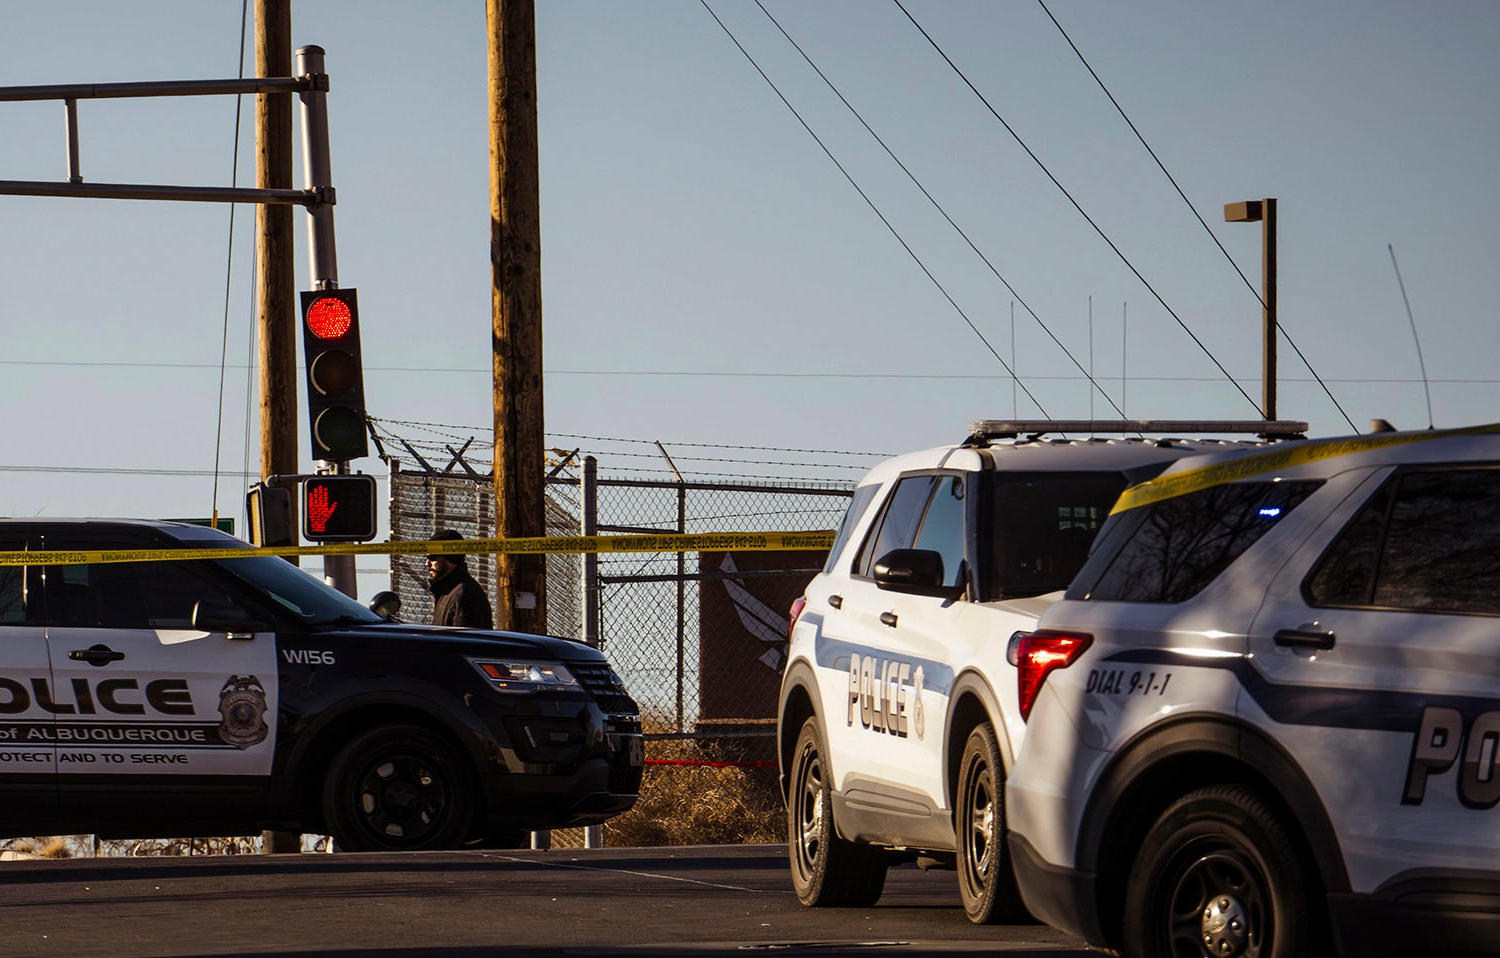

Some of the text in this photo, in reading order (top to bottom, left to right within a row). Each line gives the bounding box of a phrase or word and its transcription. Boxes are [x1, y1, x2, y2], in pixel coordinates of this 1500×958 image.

[1086, 670, 1173, 697] DIAL 9-1-1
[847, 653, 910, 739] POLICE
[26, 727, 206, 743] ALBUQUERQUE
[59, 753, 96, 764] AND
[101, 753, 125, 764] TO
[131, 753, 189, 764] SERVE
